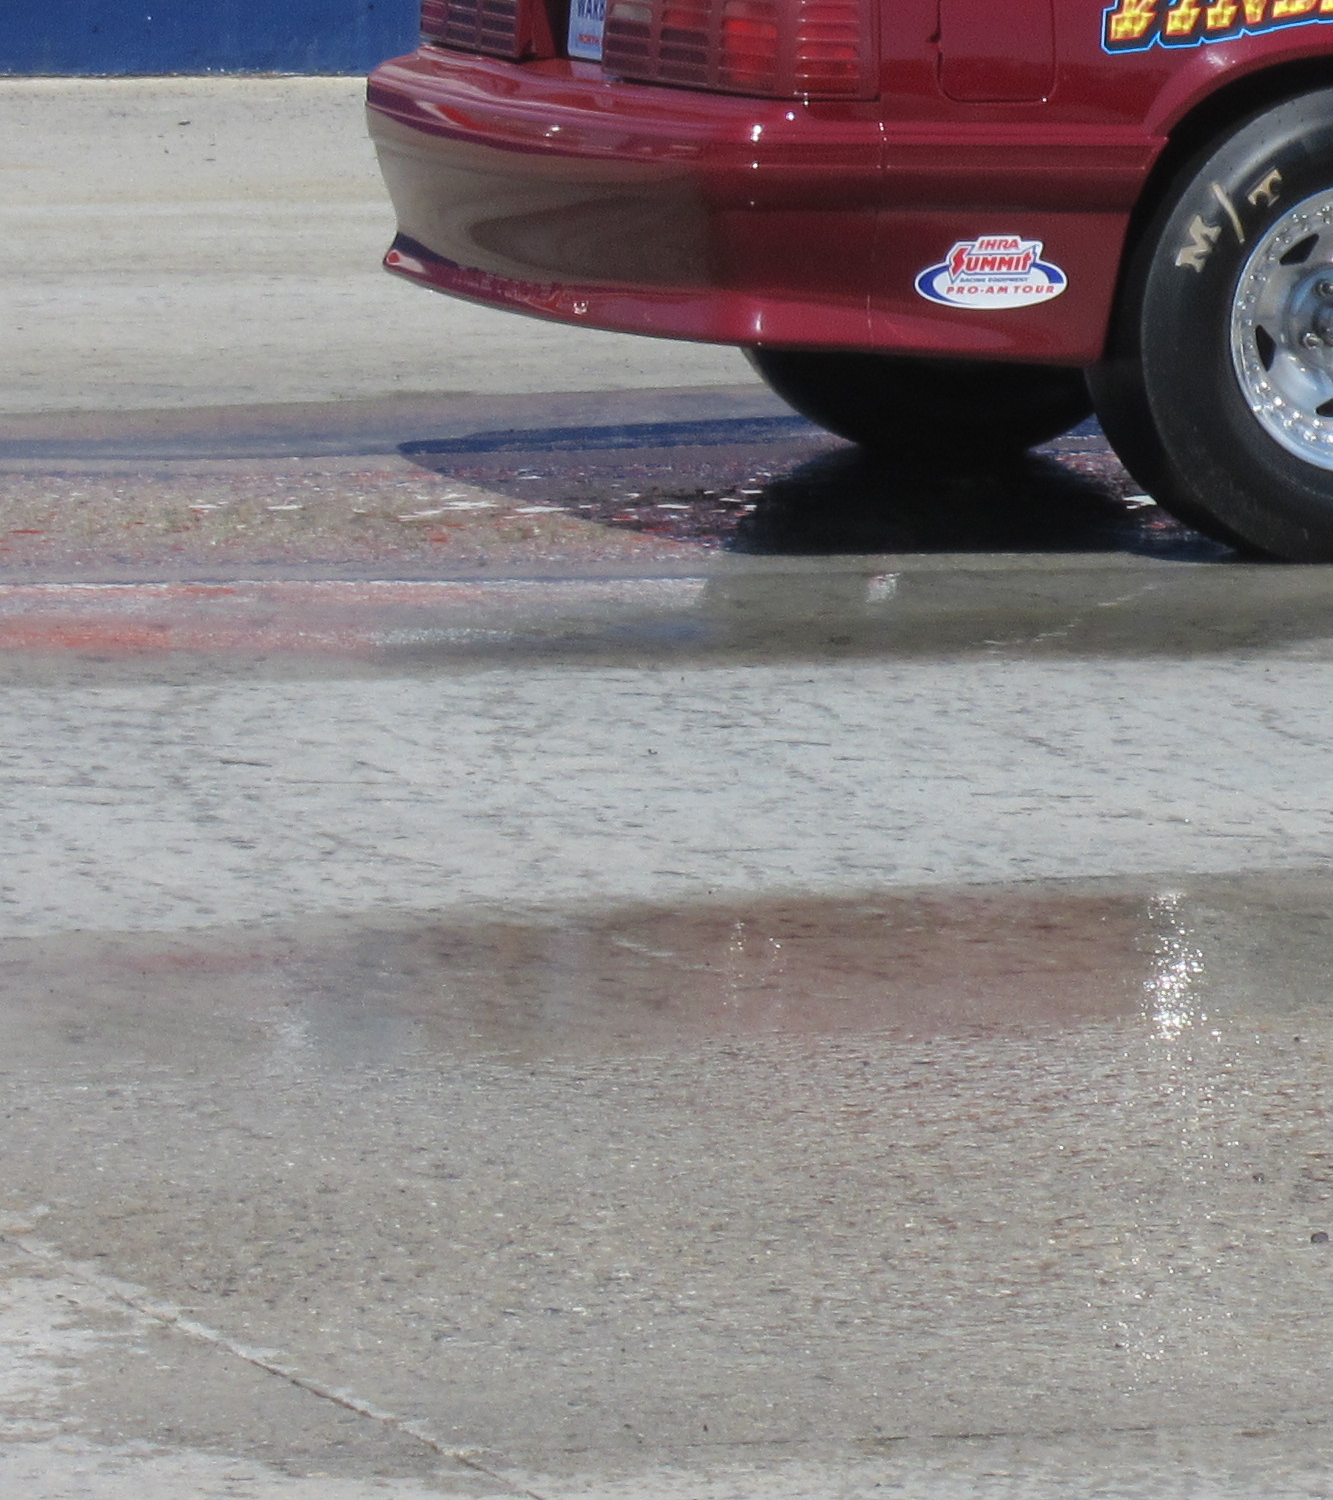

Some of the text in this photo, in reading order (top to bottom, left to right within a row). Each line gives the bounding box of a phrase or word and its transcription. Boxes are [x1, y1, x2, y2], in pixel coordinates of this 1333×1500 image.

[1174, 168, 1283, 273] M/T
[978, 238, 1020, 251] IHRA
[946, 285, 1056, 295] PRO-AM TOUR
